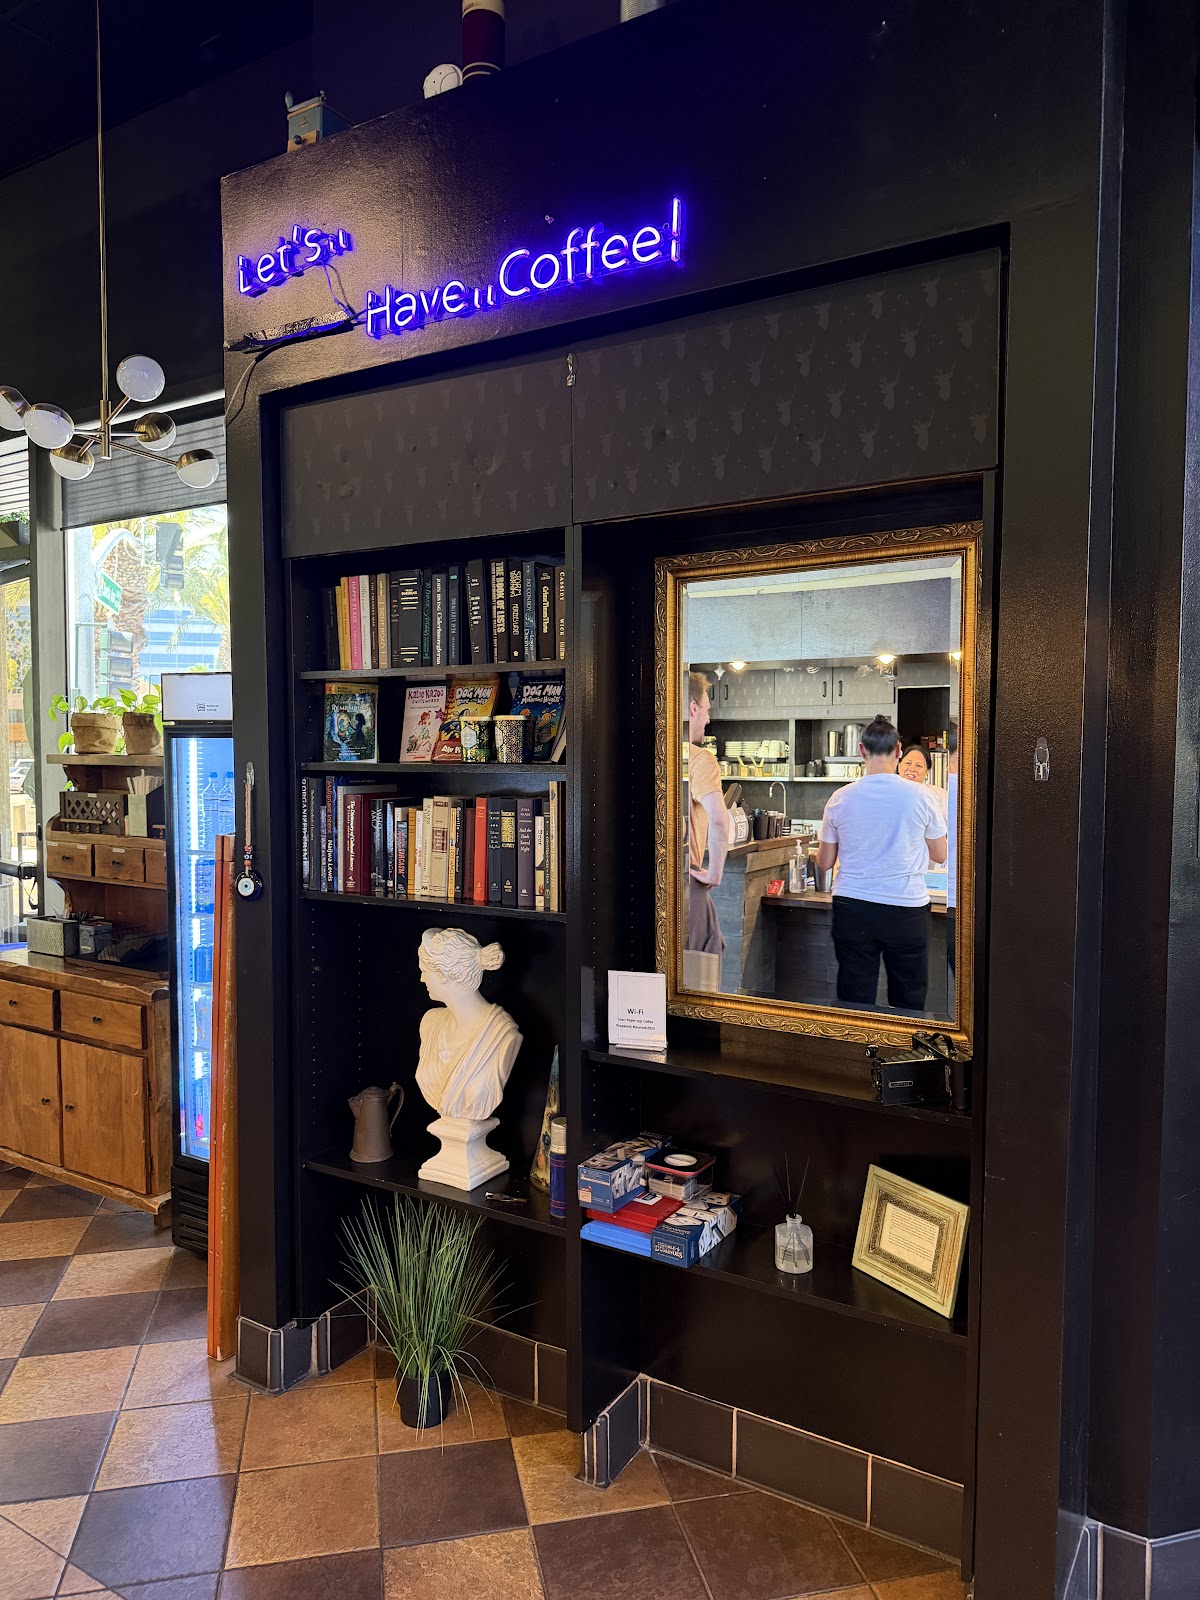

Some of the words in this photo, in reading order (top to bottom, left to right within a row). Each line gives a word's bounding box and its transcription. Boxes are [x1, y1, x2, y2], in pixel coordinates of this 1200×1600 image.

[366, 280, 467, 337] Have
[495, 561, 504, 576] THE
[496, 578, 504, 599] BOOK
[497, 600, 505, 610] OF
[497, 611, 505, 633] LISTS
[408, 689, 424, 700] Katie
[426, 689, 444, 698] Kazoo
[456, 687, 473, 699] DOG
[473, 687, 493, 698] MAN
[523, 685, 543, 696] DOG
[543, 685, 563, 696] MAN
[397, 848, 405, 875] SARCASM
